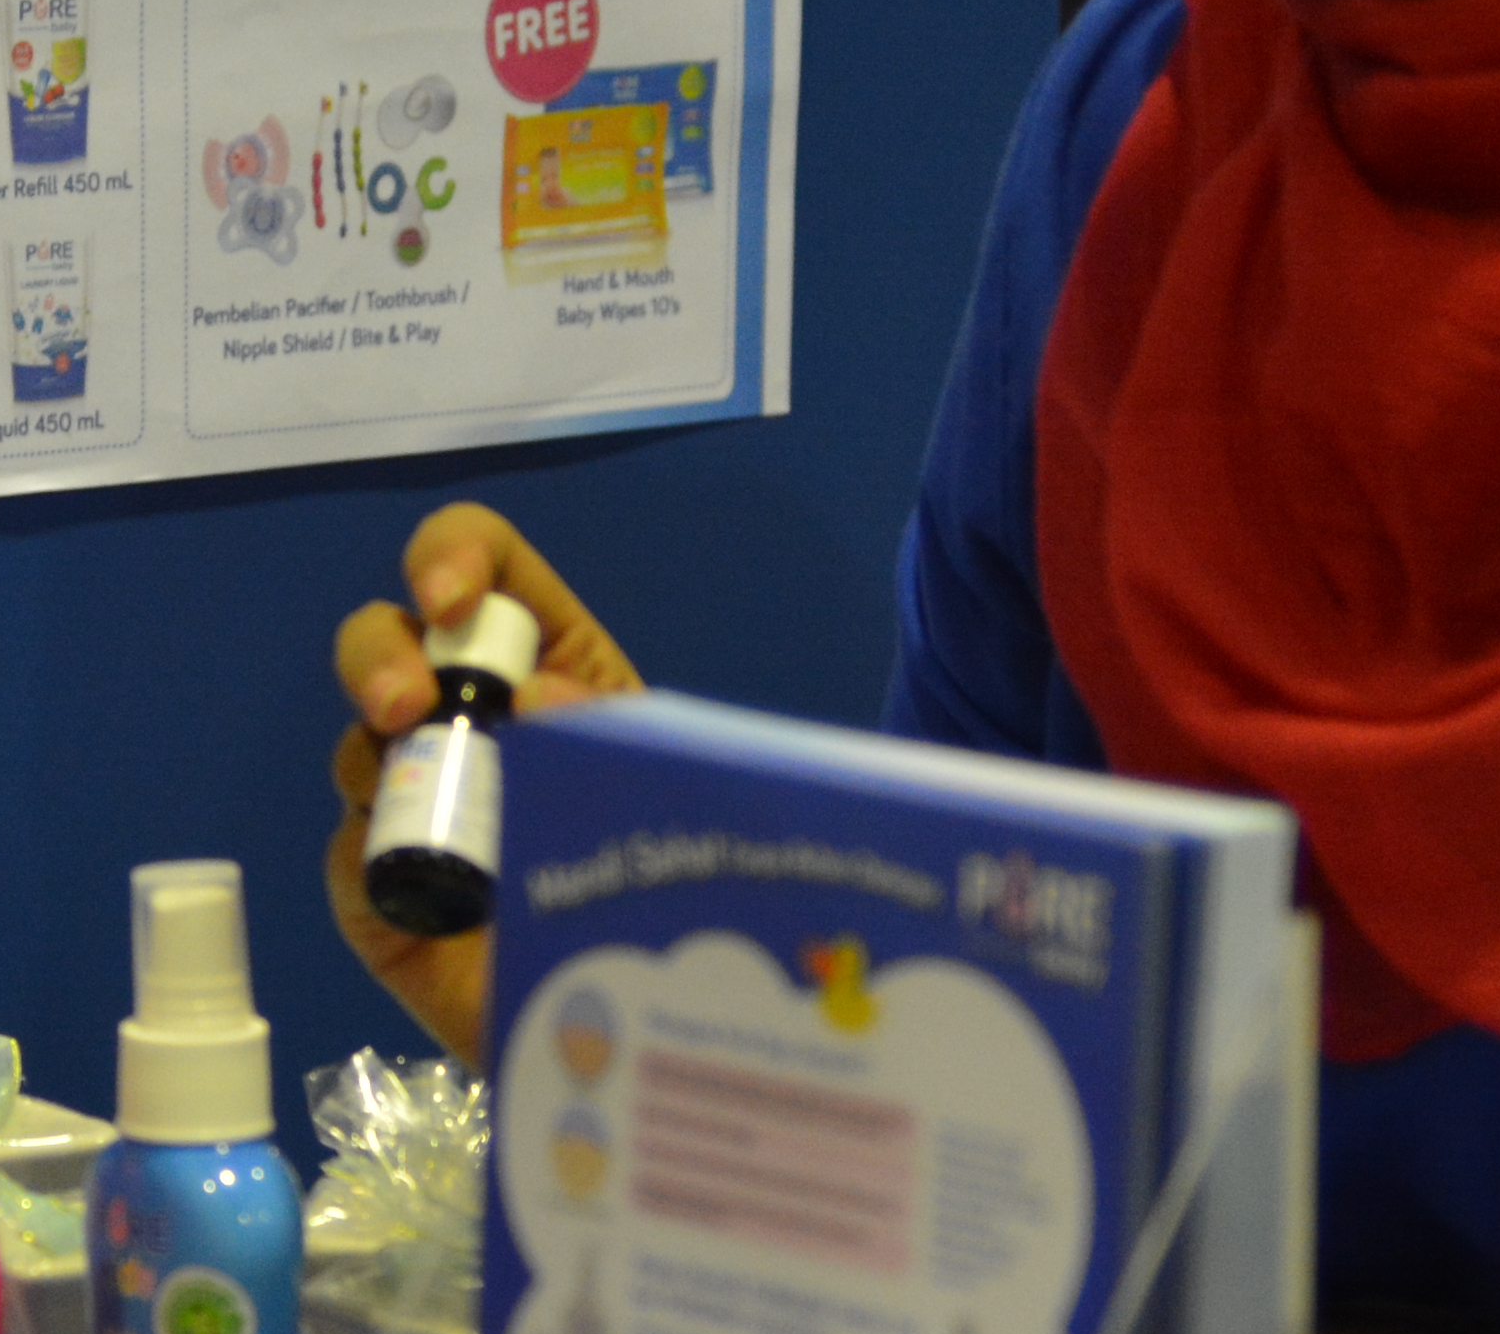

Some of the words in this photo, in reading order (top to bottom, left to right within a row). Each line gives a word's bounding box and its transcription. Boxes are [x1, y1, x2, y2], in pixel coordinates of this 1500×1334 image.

[13, 176, 59, 199] Refill
[63, 173, 101, 195] 450
[105, 170, 134, 192] mL
[562, 272, 604, 295] Hand
[625, 266, 675, 289] Mouth
[193, 302, 280, 327] Pembelian
[285, 295, 347, 320] Pacifier
[351, 291, 360, 315] /
[366, 285, 457, 311] Toothbrush
[461, 280, 470, 305] /
[556, 304, 596, 328] Baby
[600, 300, 647, 325] Wipes
[223, 335, 278, 362] Nipple
[282, 328, 334, 354] Shield
[338, 326, 347, 351] /
[351, 325, 384, 348] Bite
[388, 323, 401, 344] &
[406, 321, 441, 348] Play
[34, 412, 74, 436] 450
[78, 409, 105, 431] mL
